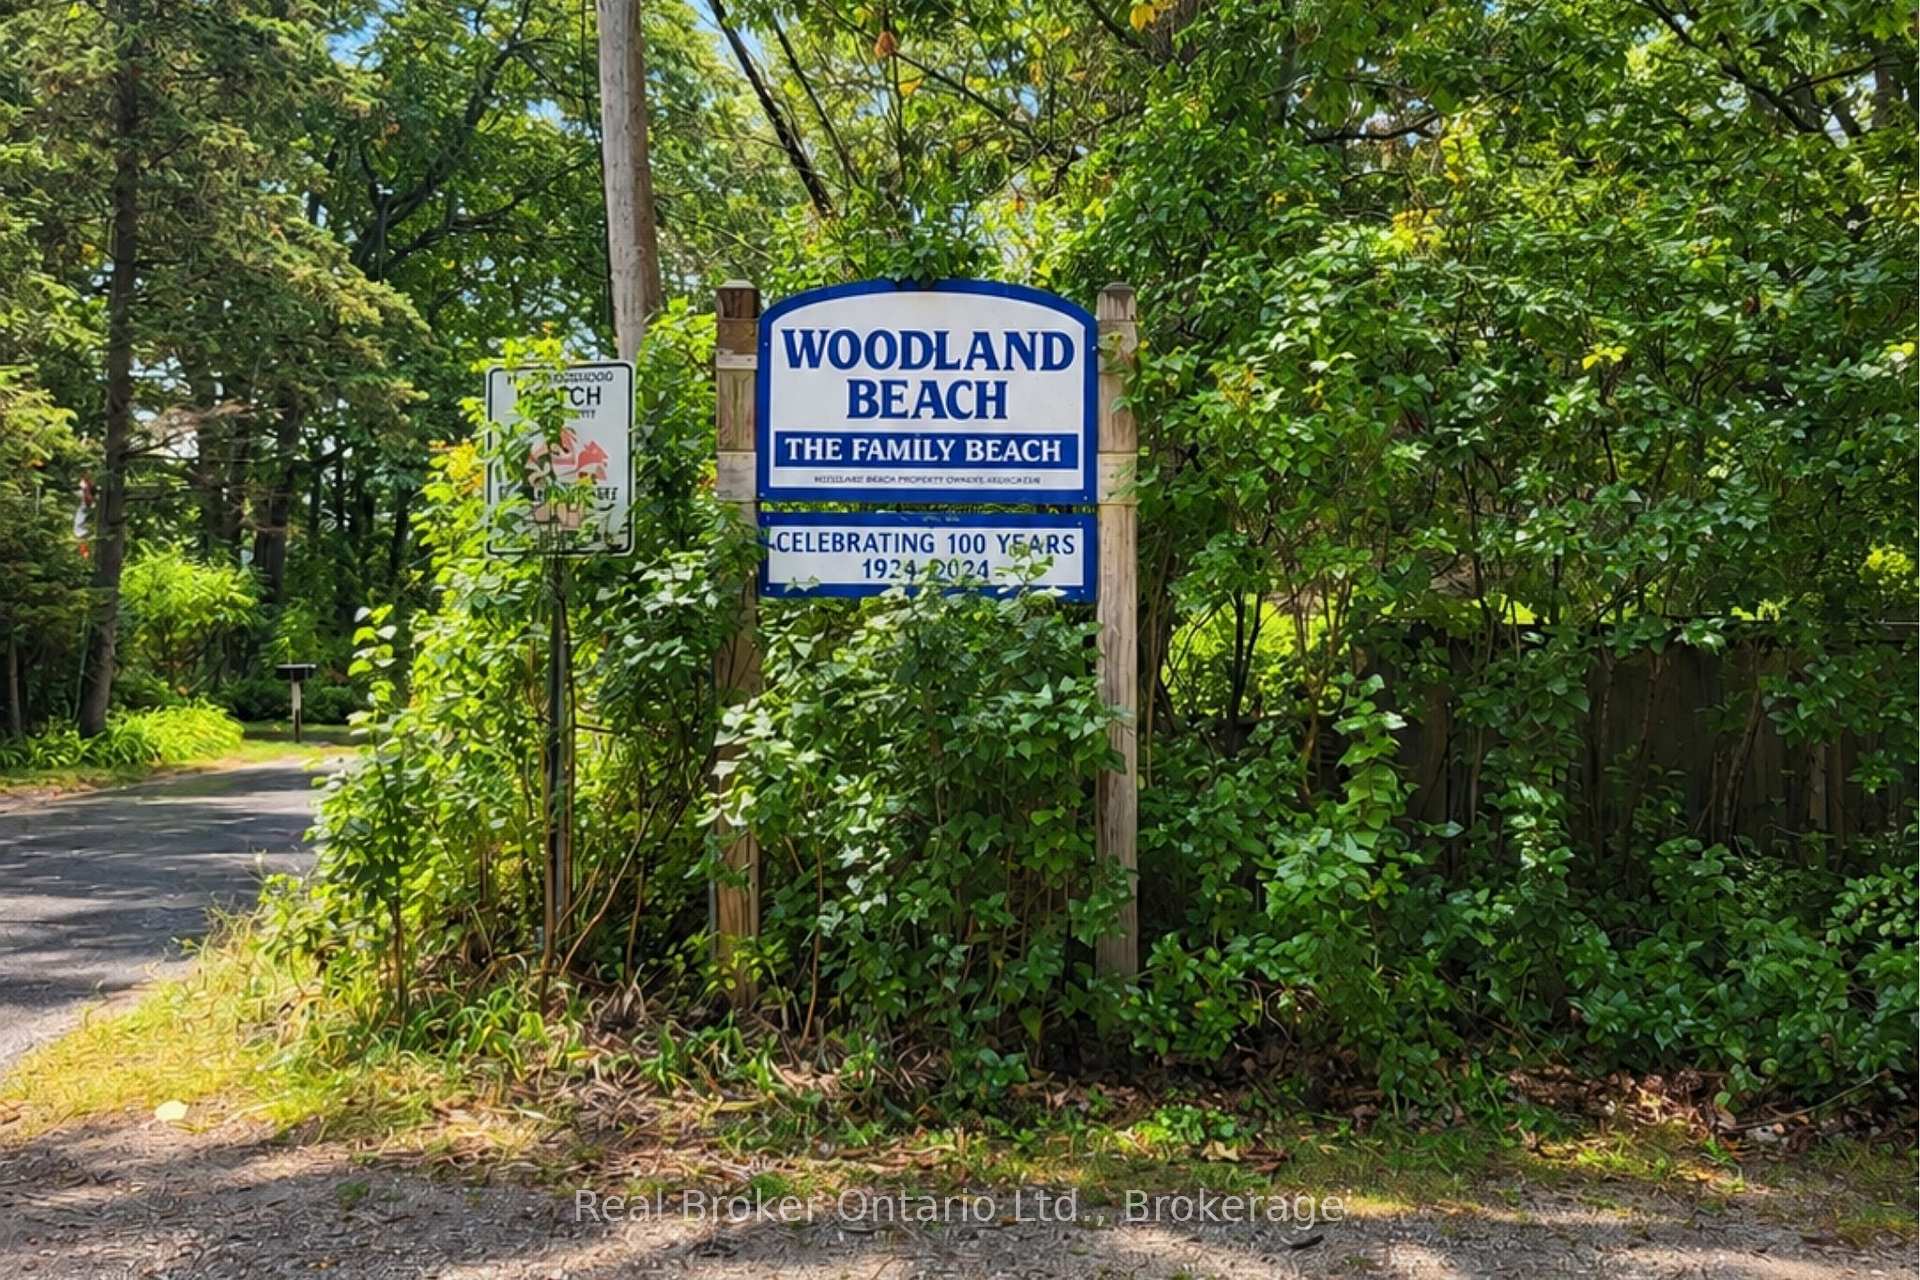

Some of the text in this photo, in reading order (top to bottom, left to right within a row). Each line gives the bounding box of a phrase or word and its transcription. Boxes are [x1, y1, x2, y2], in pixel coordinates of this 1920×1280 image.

[781, 328, 1075, 371] WOODLAND
[847, 379, 1008, 419] BEACH
[785, 437, 1061, 462] THE FAMILY BEACH
[776, 531, 1075, 555] CELEBRATING 100 YEARS
